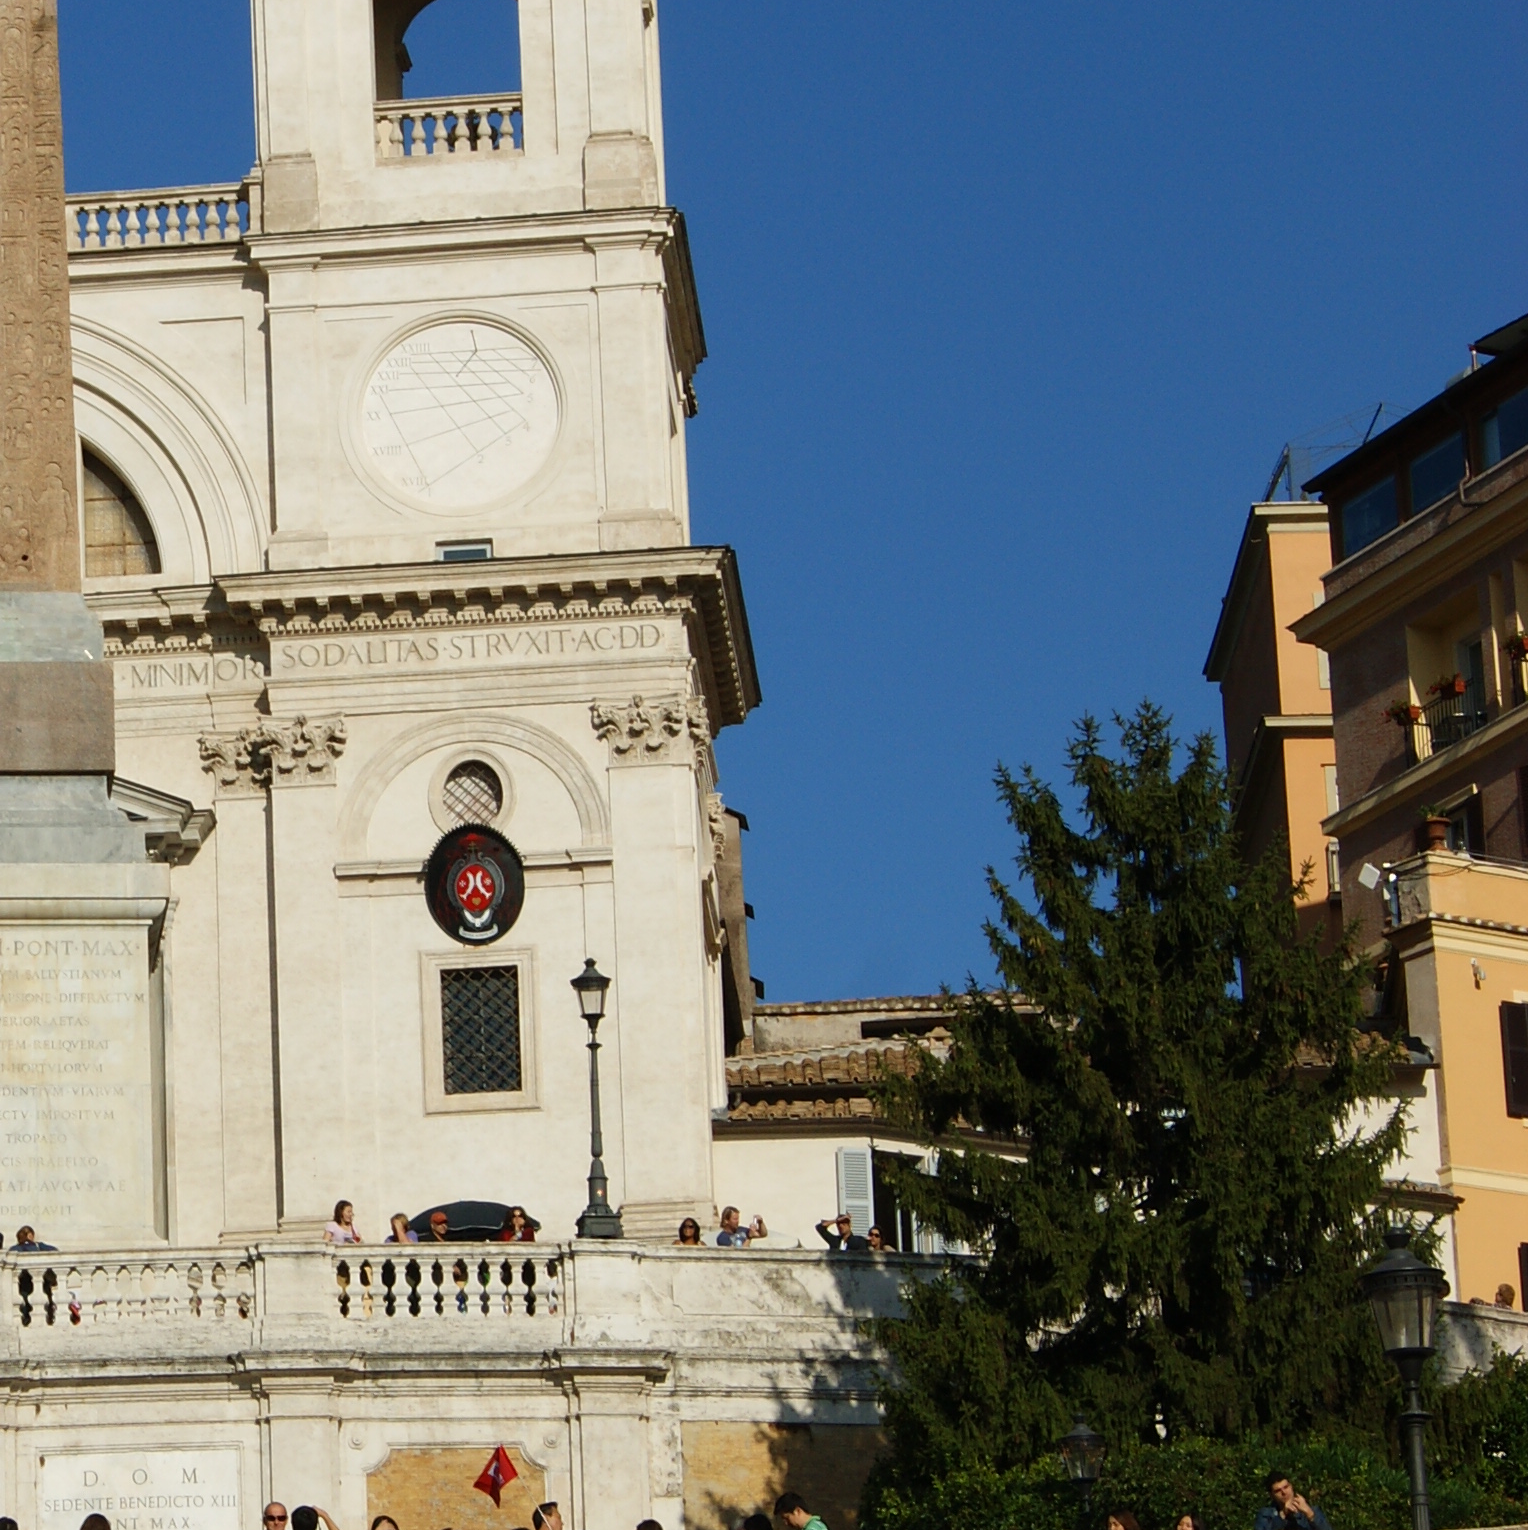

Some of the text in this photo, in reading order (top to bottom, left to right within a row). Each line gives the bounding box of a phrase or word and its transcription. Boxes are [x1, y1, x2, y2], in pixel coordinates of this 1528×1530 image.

[282, 638, 439, 669] SODALITAS
[451, 629, 570, 659] STRVXIT
[576, 626, 615, 652] AC
[620, 624, 661, 649] DD
[13, 940, 74, 957] PONT
[82, 940, 134, 956] MAX
[58, 993, 145, 1004] DIFFRACTVM
[45, 1495, 237, 1512] SEDENTE BENEDICTO XIII
[151, 1517, 190, 1529] MAX
